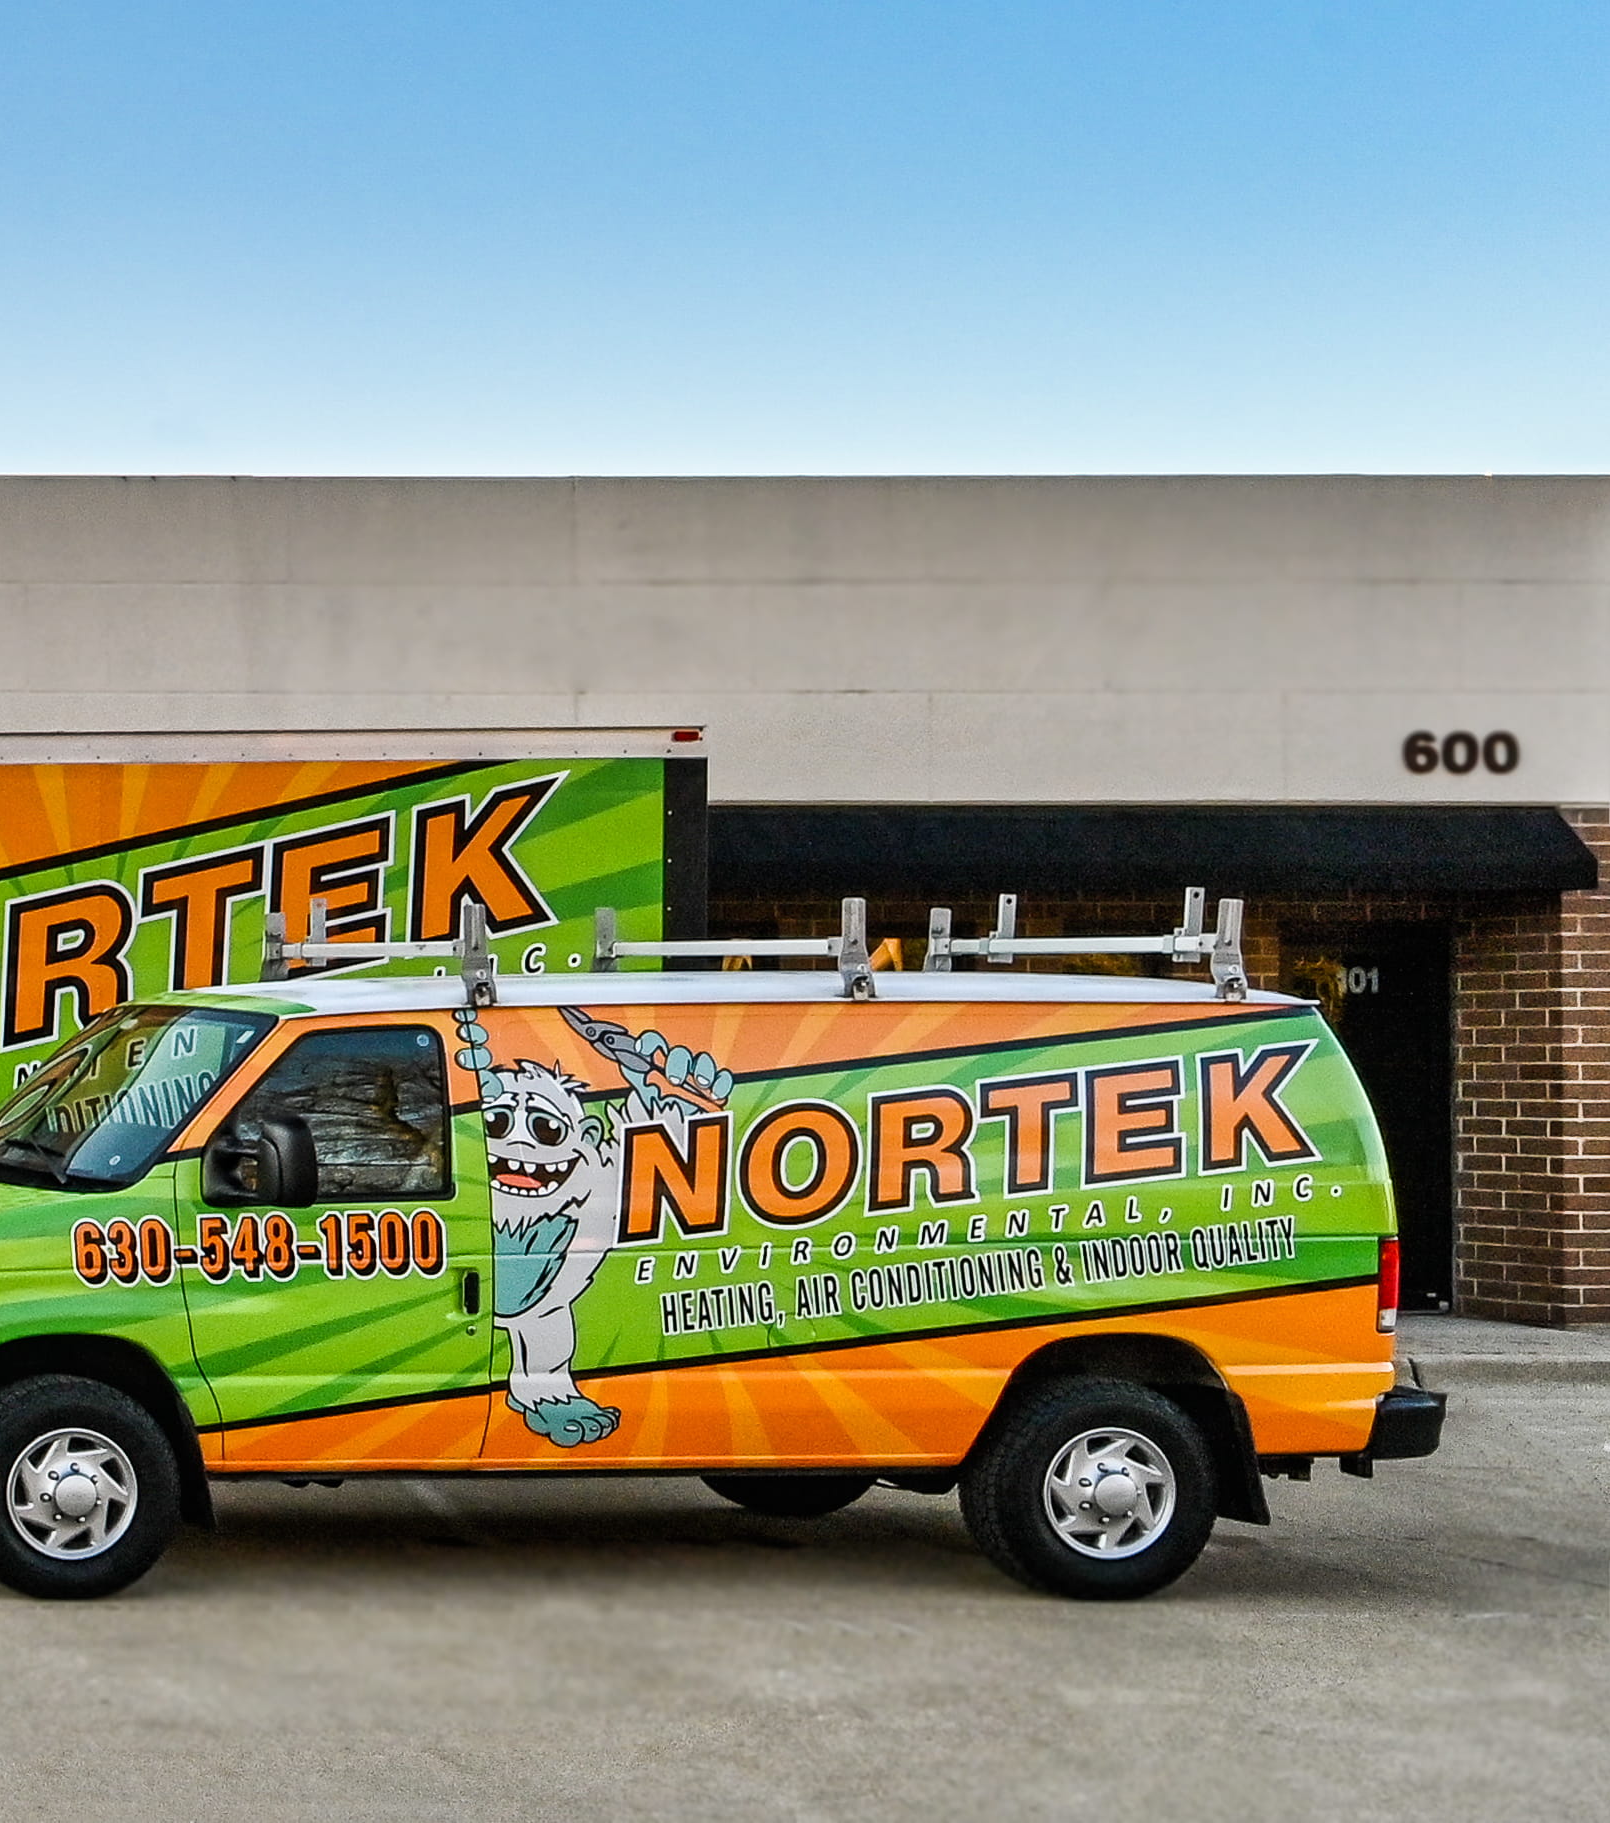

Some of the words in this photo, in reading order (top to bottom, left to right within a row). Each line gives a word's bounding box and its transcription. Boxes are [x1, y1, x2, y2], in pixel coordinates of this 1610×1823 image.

[1403, 729, 1520, 775] 600
[614, 1038, 1321, 1246] NORTEK
[70, 1207, 447, 1288] 630-548-1500
[634, 1195, 1173, 1284] ENVIRONMENTAL,
[1220, 1174, 1342, 1211] INC.
[660, 1281, 785, 1336] HEATING,
[794, 1273, 842, 1320] AIR
[849, 1247, 1045, 1312] CONDITIONING
[1051, 1244, 1073, 1287] &
[1080, 1230, 1184, 1283] INDOOR
[1190, 1215, 1295, 1272] QUALITY
